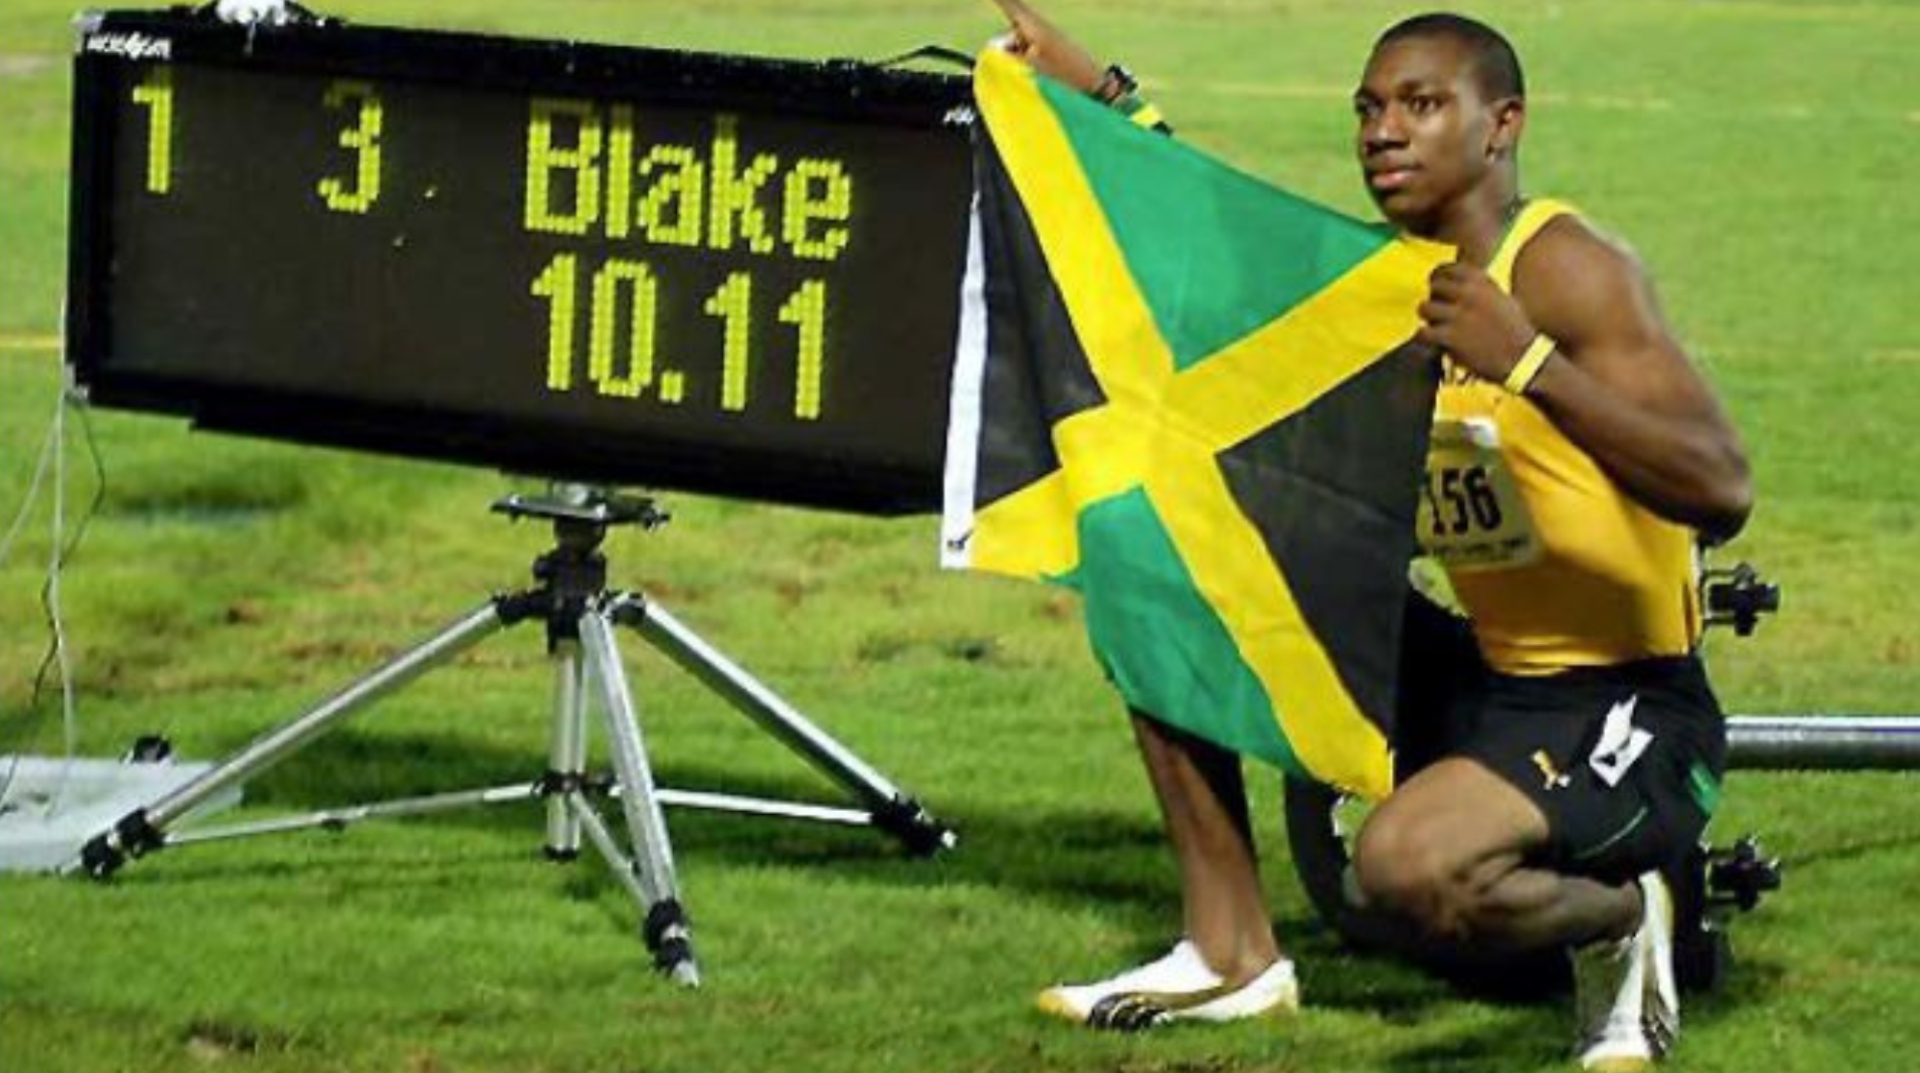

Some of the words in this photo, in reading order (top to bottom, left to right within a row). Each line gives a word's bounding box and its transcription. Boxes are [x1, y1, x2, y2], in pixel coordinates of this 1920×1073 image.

[133, 67, 173, 194] 1
[317, 82, 383, 213] 3
[525, 99, 852, 260] Blake
[531, 253, 826, 419] 10.11
